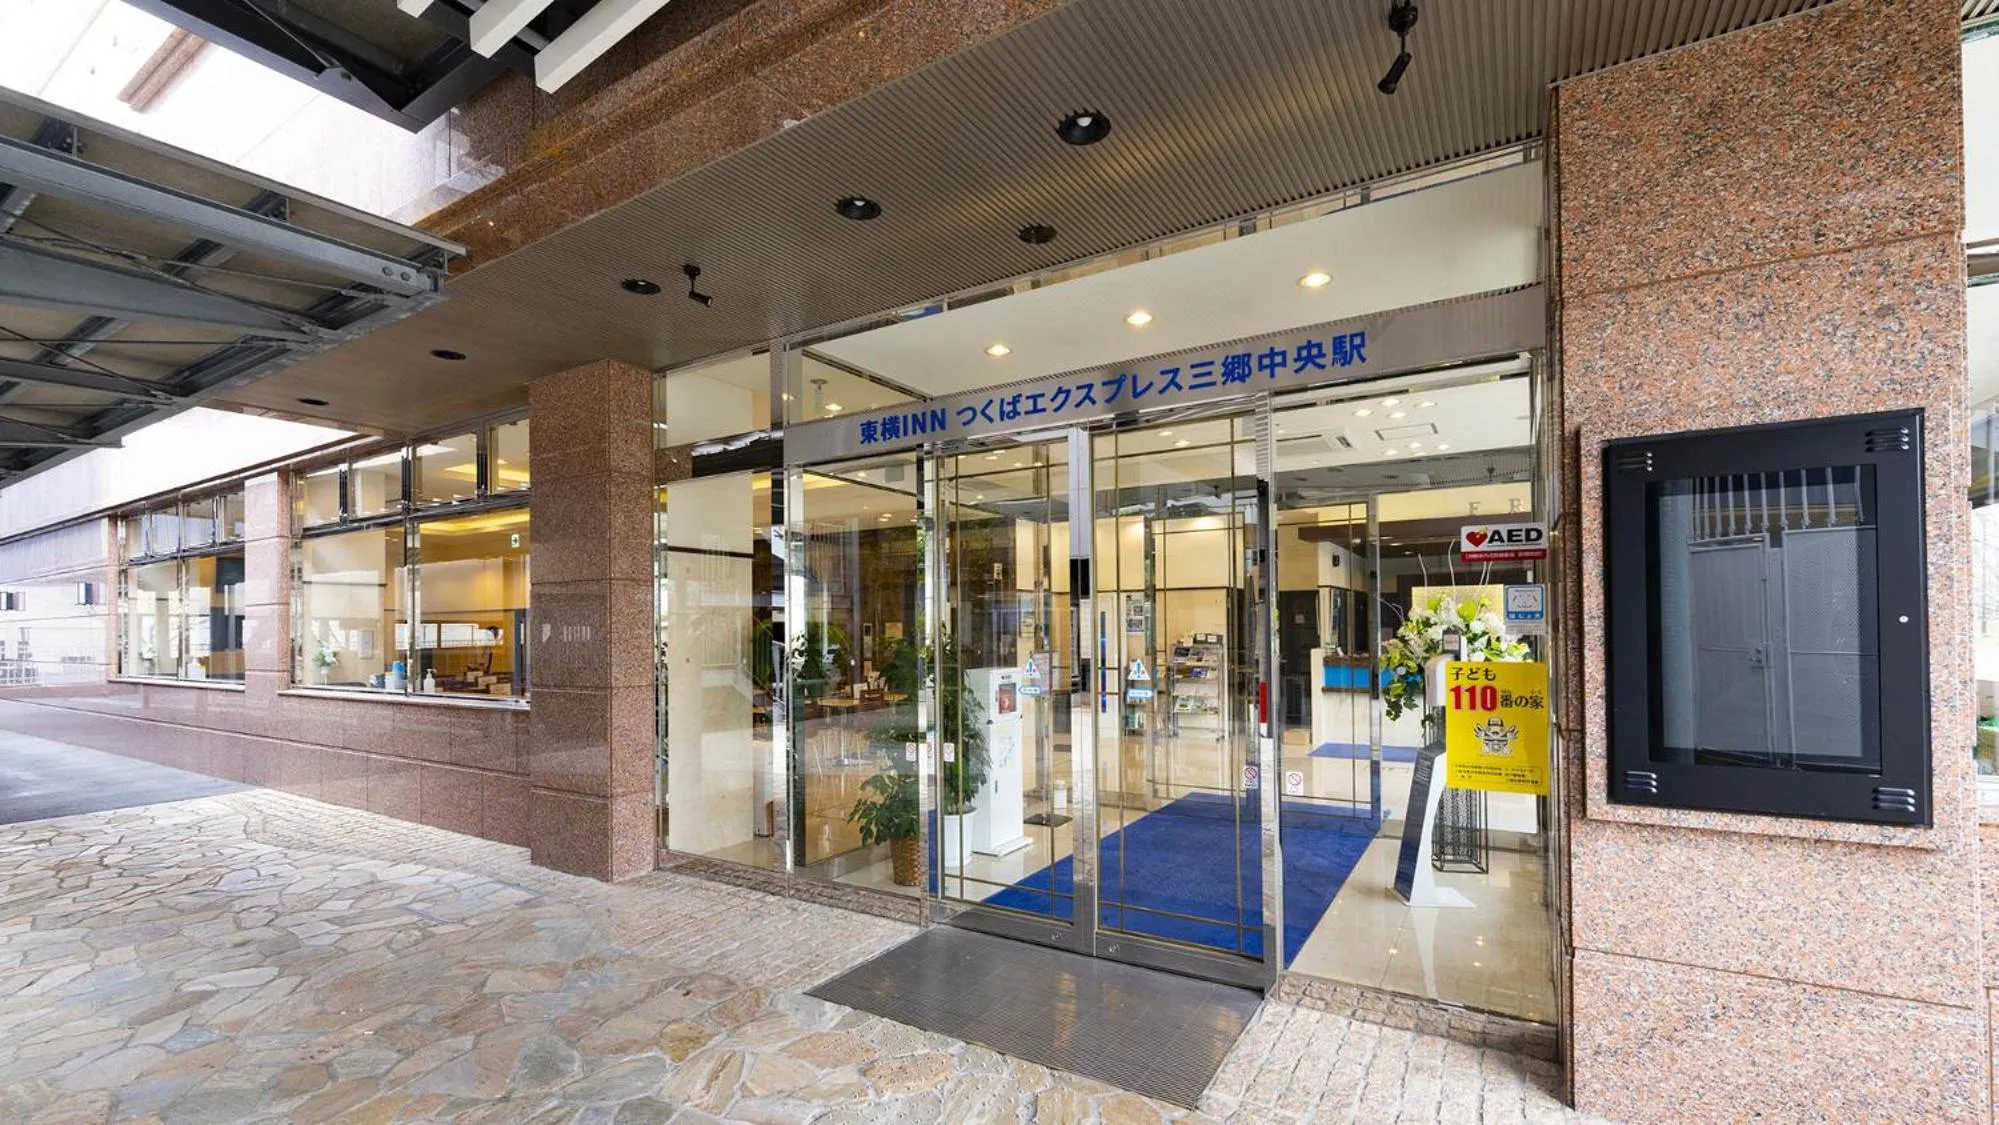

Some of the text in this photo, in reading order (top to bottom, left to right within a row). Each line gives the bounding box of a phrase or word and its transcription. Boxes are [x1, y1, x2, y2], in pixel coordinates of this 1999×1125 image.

[860, 330, 1368, 445] 東横INN つくばエクスプレス三郷中央駅
[1488, 527, 1543, 545] AED
[1450, 667, 1496, 682] 子ども
